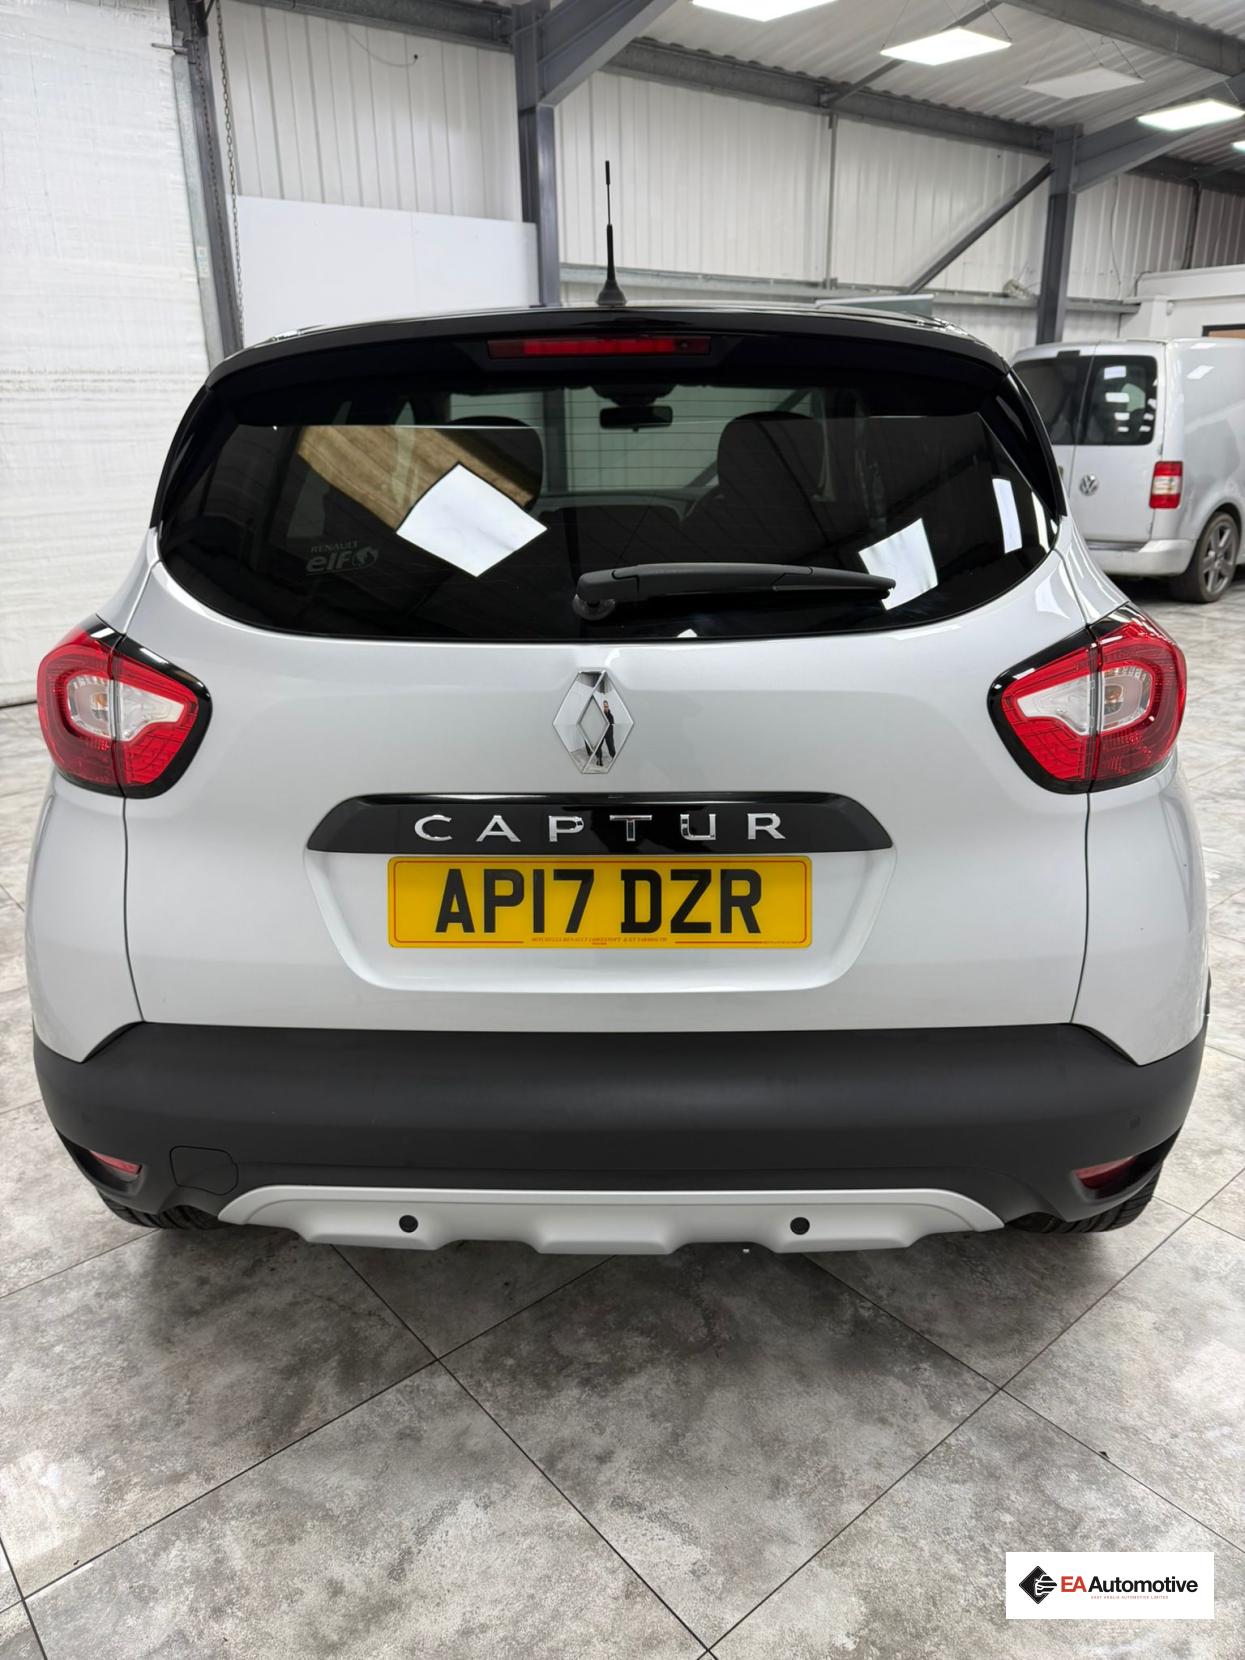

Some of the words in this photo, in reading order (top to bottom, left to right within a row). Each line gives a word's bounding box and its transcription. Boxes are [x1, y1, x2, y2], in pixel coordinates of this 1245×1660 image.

[311, 540, 358, 553] RENAULT
[414, 813, 787, 843] CAPTUR
[434, 868, 595, 934] AP17
[620, 868, 763, 934] DZR
